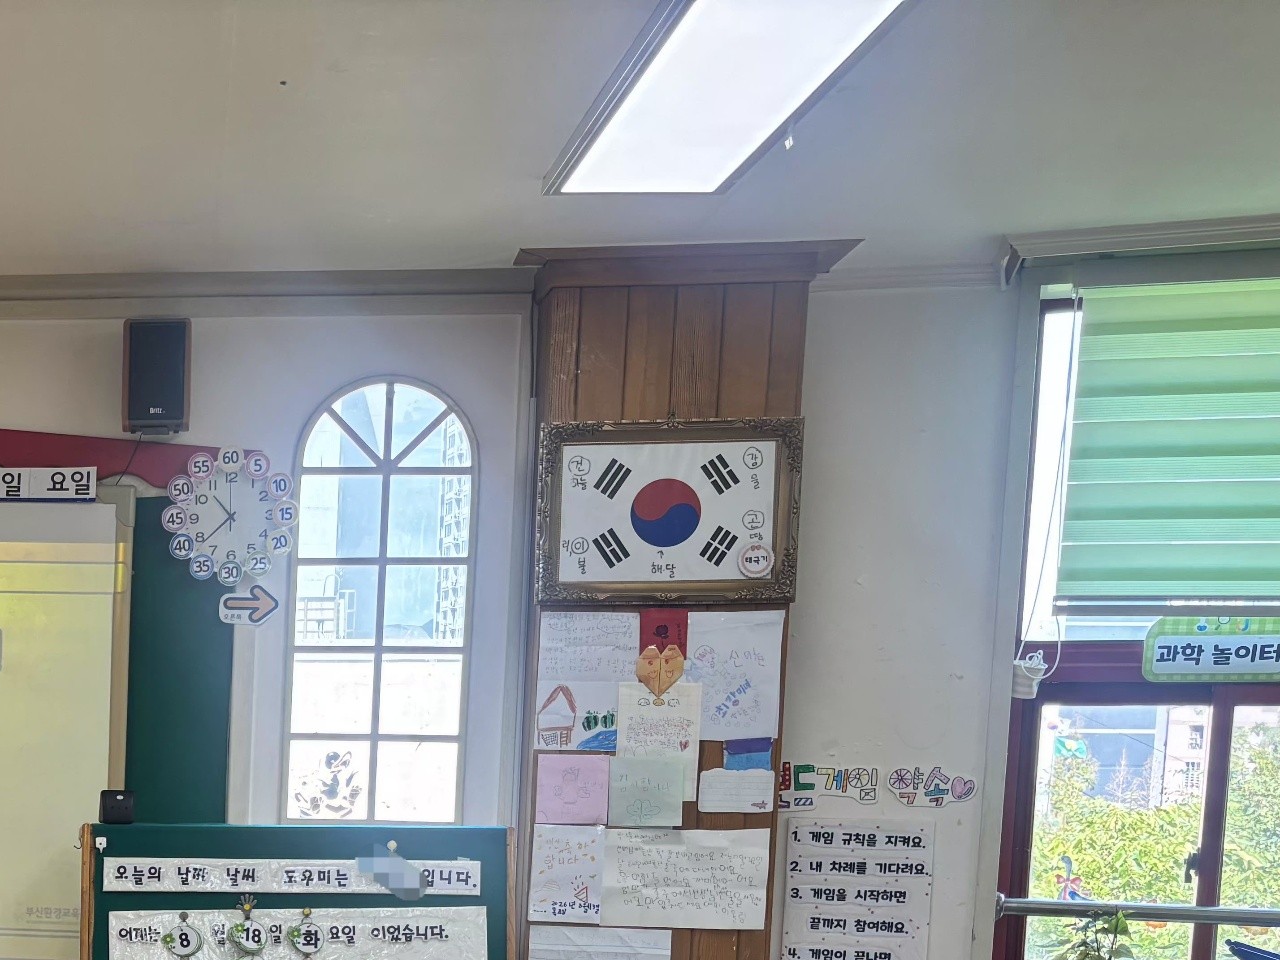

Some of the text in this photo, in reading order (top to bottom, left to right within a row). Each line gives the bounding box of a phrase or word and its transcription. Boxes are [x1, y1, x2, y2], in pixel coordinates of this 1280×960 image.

[222, 450, 239, 464] 60
[193, 460, 210, 474] 55
[254, 459, 262, 472] 5
[1, 472, 21, 497] 일
[46, 471, 90, 496] 요일
[225, 472, 238, 483] 12
[173, 482, 190, 496] 50
[208, 480, 217, 491] 11
[272, 479, 287, 492] 10
[195, 494, 208, 505] 10
[259, 491, 269, 501] 2
[166, 512, 183, 525] 45
[189, 513, 199, 524] 9
[278, 507, 292, 520] 15
[195, 532, 205, 543] 8
[259, 529, 268, 540] 4
[174, 539, 191, 552] 40
[272, 535, 287, 549] 20
[209, 545, 218, 556] 7
[226, 550, 236, 561] 6
[251, 557, 267, 570] 25
[745, 555, 768, 564] 태극기
[194, 560, 210, 573] 35
[223, 567, 239, 579] 30
[1156, 643, 1280, 666] 과학 놀이터
[888, 767, 950, 806] 약속
[791, 831, 926, 849] 1. 게임 규칙을 지켜요.
[790, 861, 929, 876] 2. 내 차례를 기다려요.
[115, 865, 161, 883] 오늘의
[226, 867, 256, 886] 날씨
[284, 868, 349, 887] 도우미는
[423, 867, 477, 888] 입니다.
[790, 888, 907, 904] 3. 게임을 시작하면
[809, 916, 908, 934] 끝까지 참여해요.
[119, 926, 161, 943] 어제는
[178, 932, 191, 948] 8
[243, 928, 262, 944] 18
[269, 924, 282, 944] 일
[302, 929, 320, 948] 화
[329, 925, 356, 944] 요일
[371, 924, 449, 942] 이었습니다.
[787, 948, 801, 960] 4.
